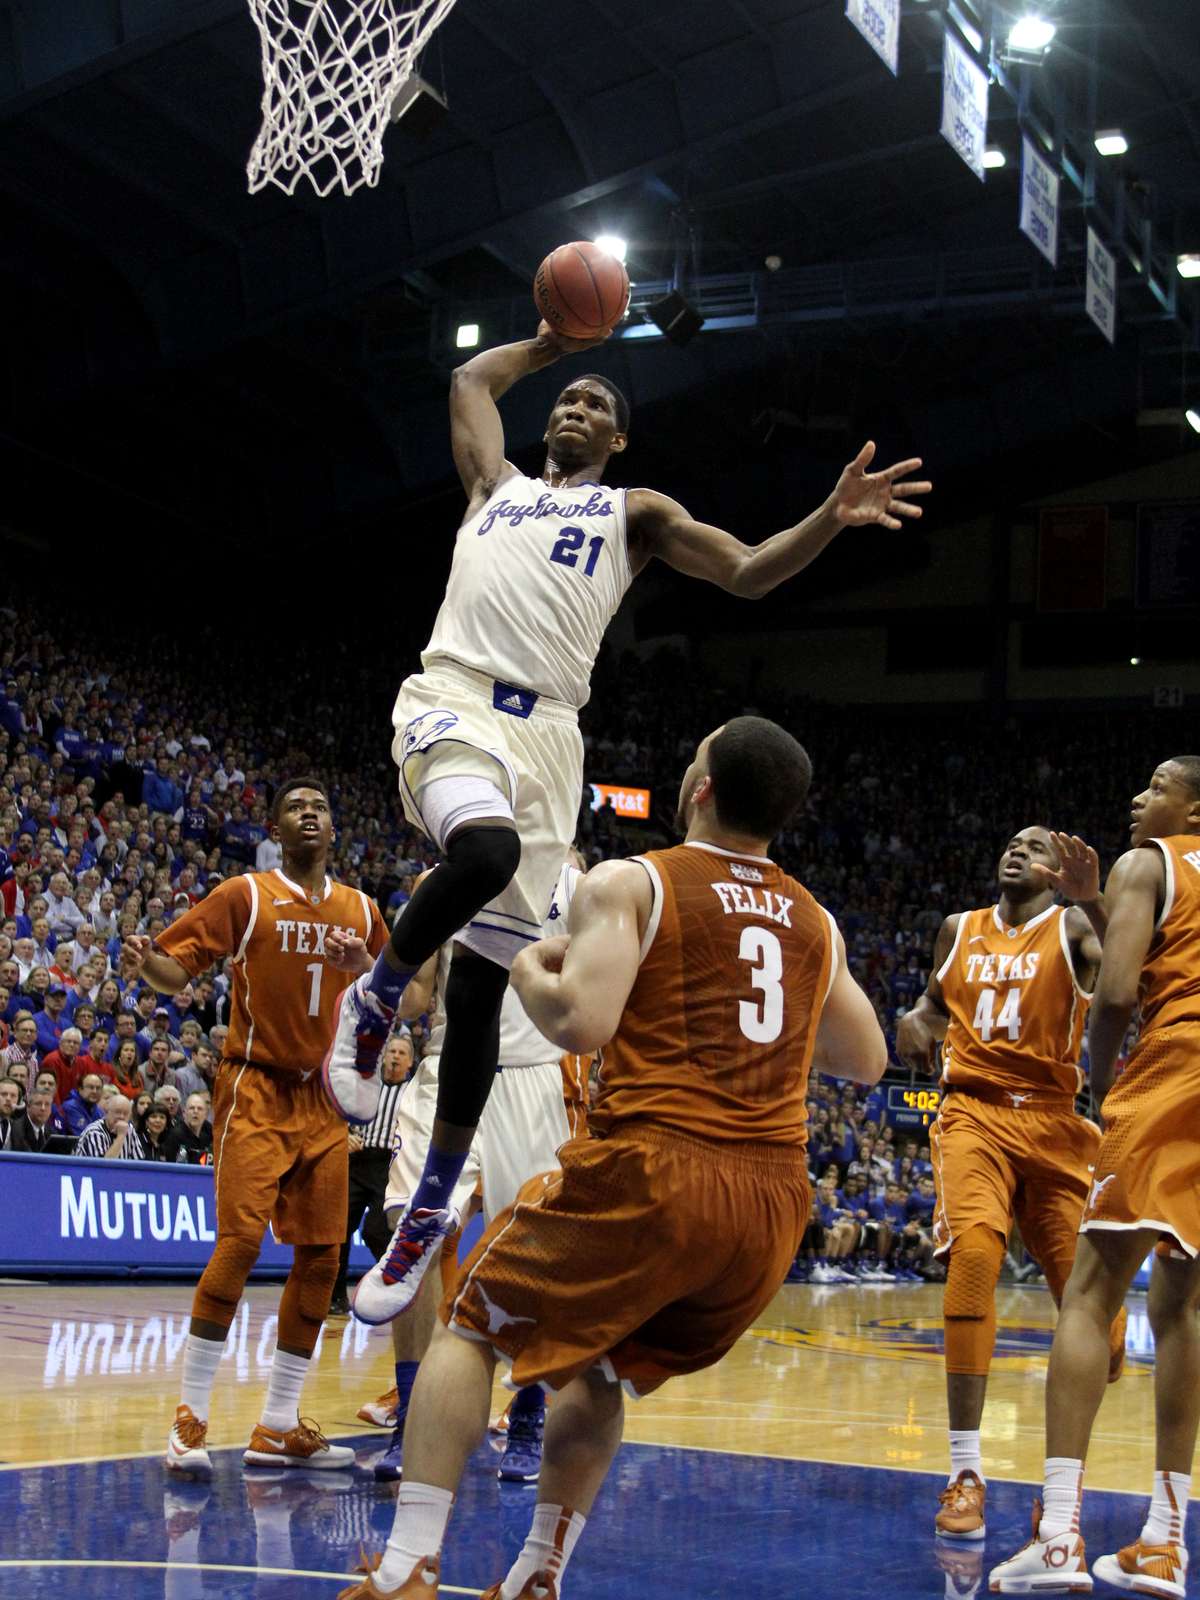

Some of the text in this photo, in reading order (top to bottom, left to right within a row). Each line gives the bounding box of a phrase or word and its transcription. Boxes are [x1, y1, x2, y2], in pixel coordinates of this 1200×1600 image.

[477, 492, 614, 536] Jayhawks
[549, 526, 605, 577] 21
[711, 882, 794, 928] FELIX
[276, 919, 356, 955] TEX
[306, 962, 323, 1017] 1
[738, 926, 784, 1044] 3
[965, 952, 1040, 983] TEXAS
[973, 988, 1021, 1041] 44
[903, 1091, 940, 1111] 4:02
